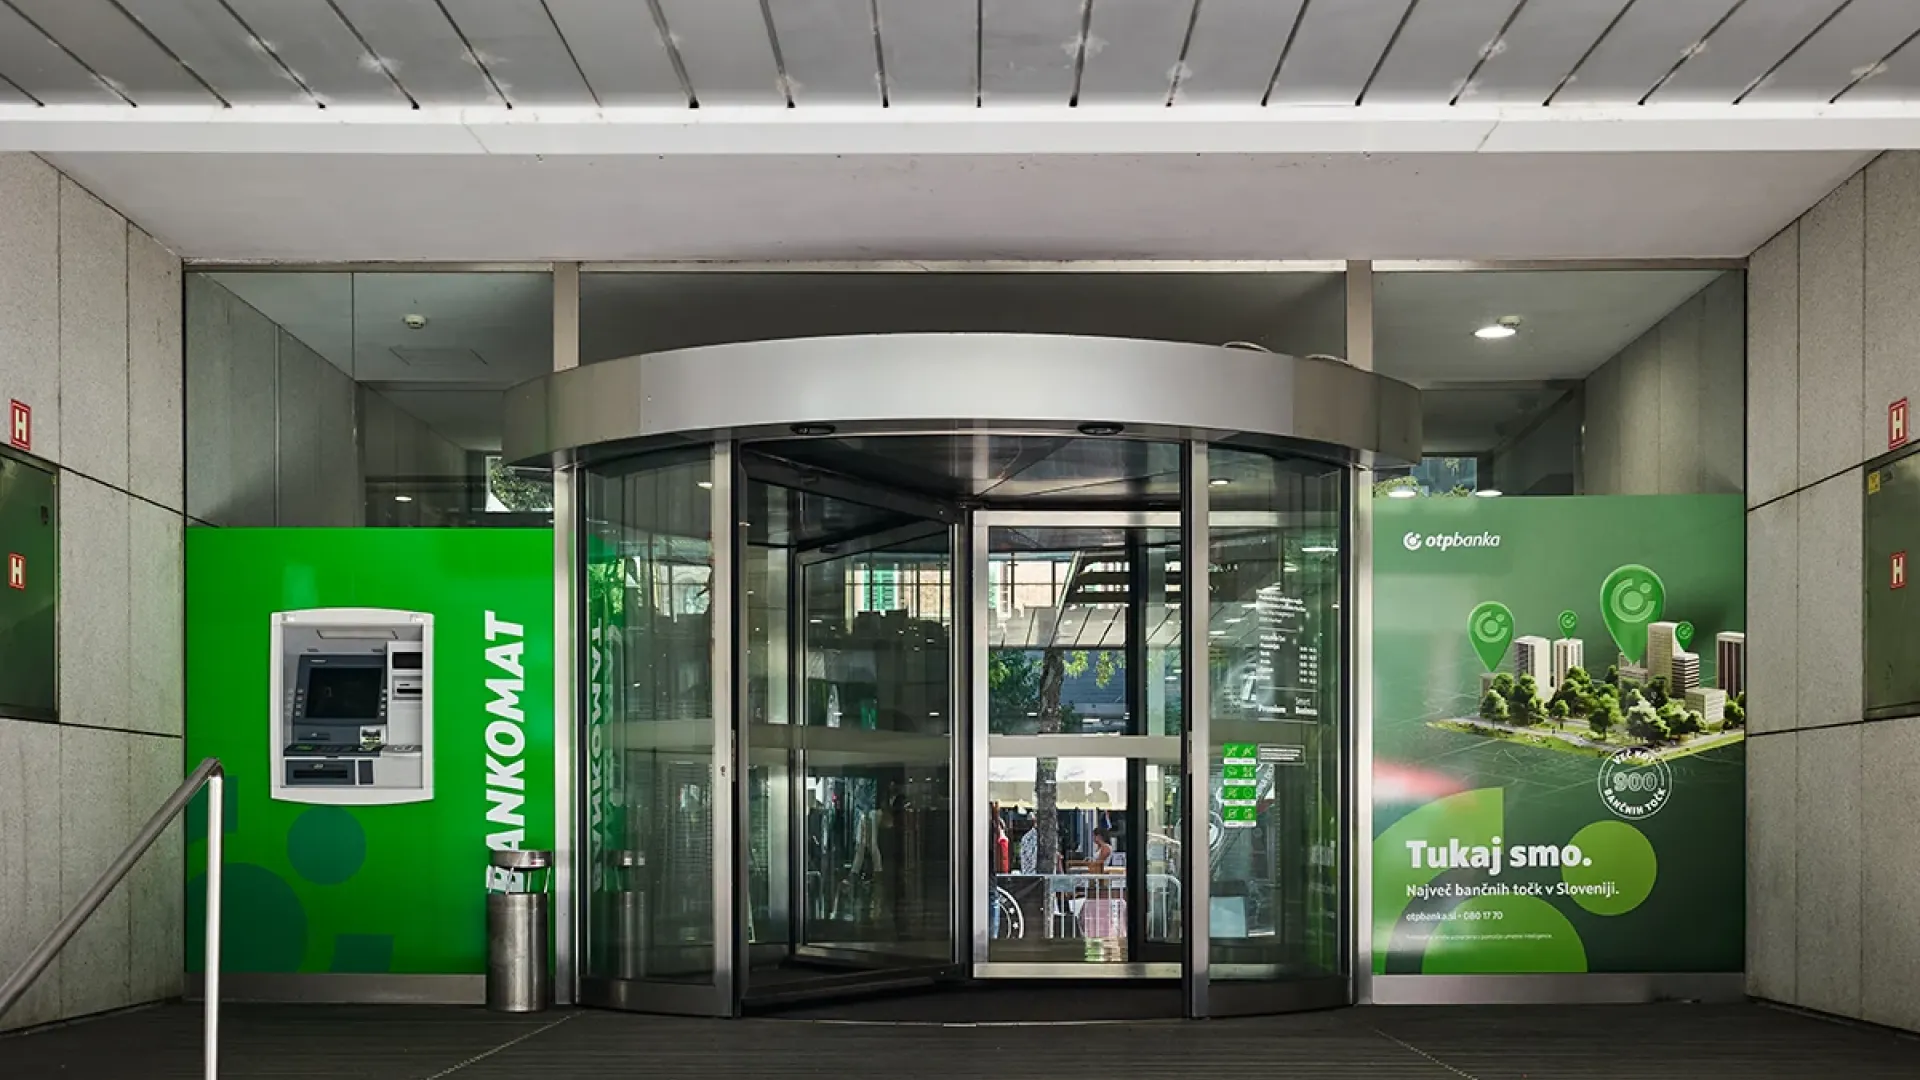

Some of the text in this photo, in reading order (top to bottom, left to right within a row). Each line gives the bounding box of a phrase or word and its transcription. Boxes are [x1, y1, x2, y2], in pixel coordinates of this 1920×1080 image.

[15, 408, 28, 442] H
[1892, 408, 1904, 441] H
[1424, 531, 1501, 551] otpbanka
[12, 556, 23, 585] H
[1892, 557, 1904, 584] H
[1612, 771, 1658, 792] 900
[1603, 787, 1645, 816] BANČNIH
[1405, 835, 1593, 876] Tukaj smo.
[1405, 880, 1620, 900] Največ bančnih točk v Sloveniji.
[1405, 910, 1504, 922] otpbanka.si 080 17 70
